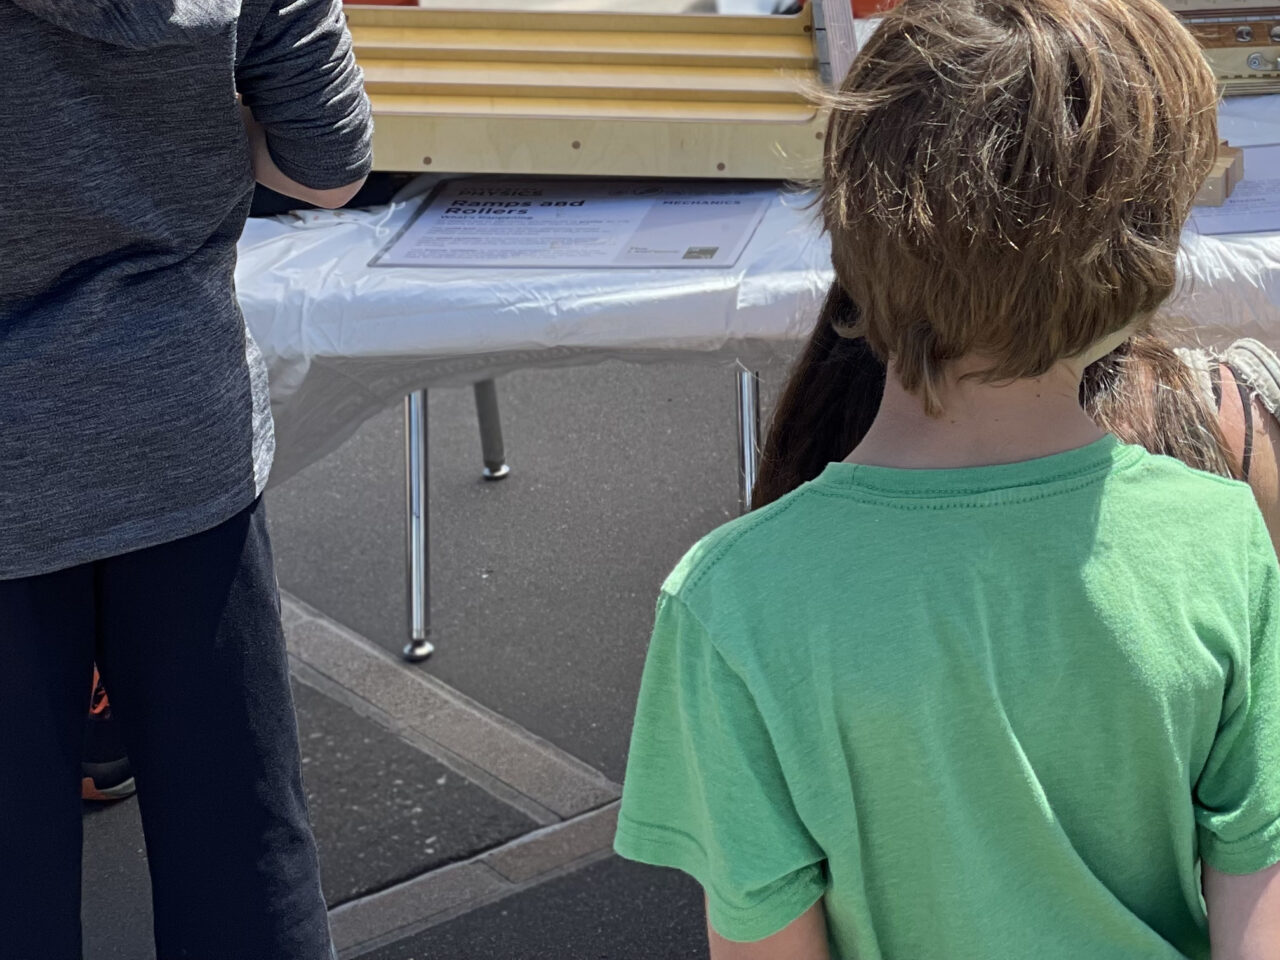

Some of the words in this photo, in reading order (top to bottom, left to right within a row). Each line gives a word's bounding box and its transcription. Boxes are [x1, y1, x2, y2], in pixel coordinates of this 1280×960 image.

[450, 199, 532, 208] Ramps
[538, 199, 586, 208] and
[444, 207, 529, 215] Rollers
